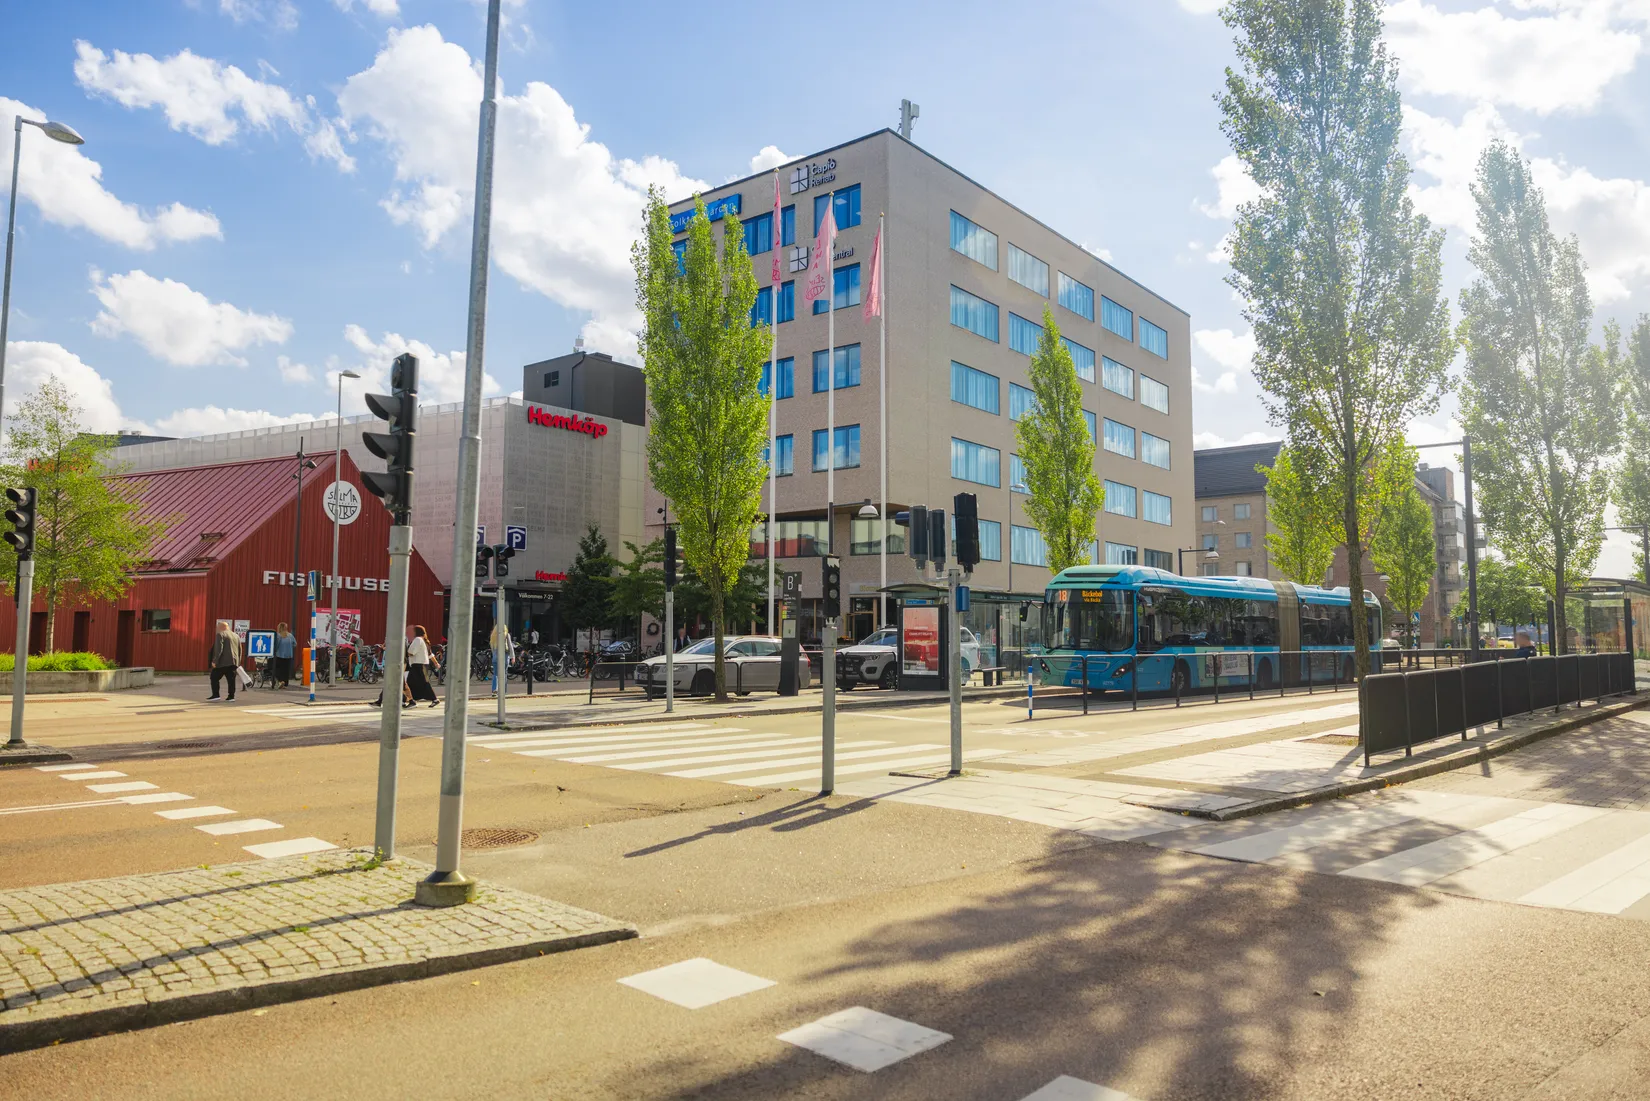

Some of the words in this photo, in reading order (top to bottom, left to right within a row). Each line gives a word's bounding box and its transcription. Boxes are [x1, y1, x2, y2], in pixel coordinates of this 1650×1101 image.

[811, 160, 836, 175] Capio
[811, 173, 836, 187] Rehab
[528, 405, 608, 439] Hemköp
[513, 533, 522, 548] P
[262, 570, 390, 592] FISHUSE
[787, 575, 794, 591] B
[1059, 590, 1068, 602] 18
